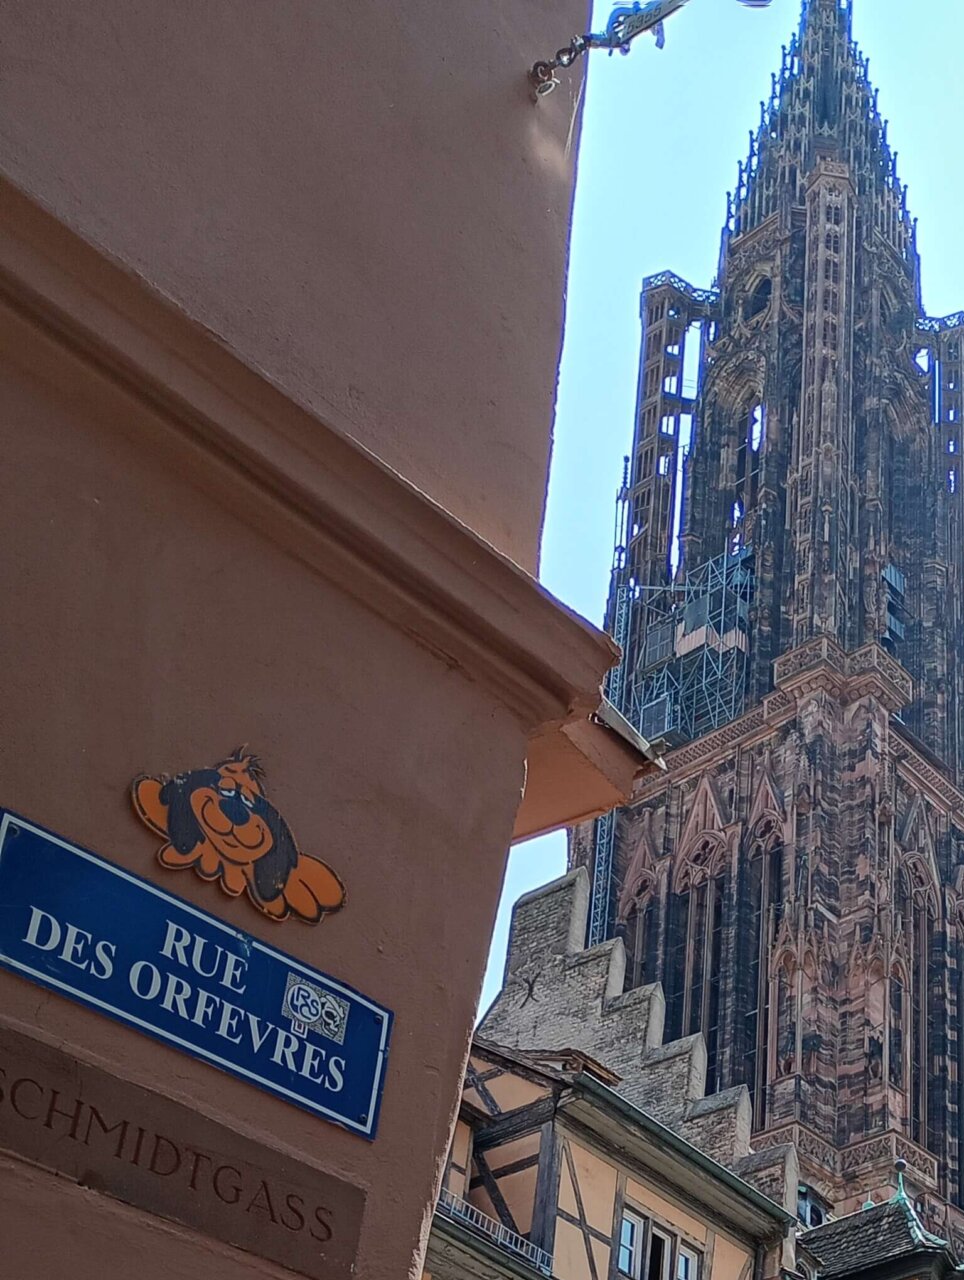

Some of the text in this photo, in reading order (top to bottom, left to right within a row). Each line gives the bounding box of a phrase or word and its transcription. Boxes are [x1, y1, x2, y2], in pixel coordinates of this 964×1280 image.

[22, 905, 346, 1092] DES ORFEVRES
[160, 919, 249, 995] RUE
